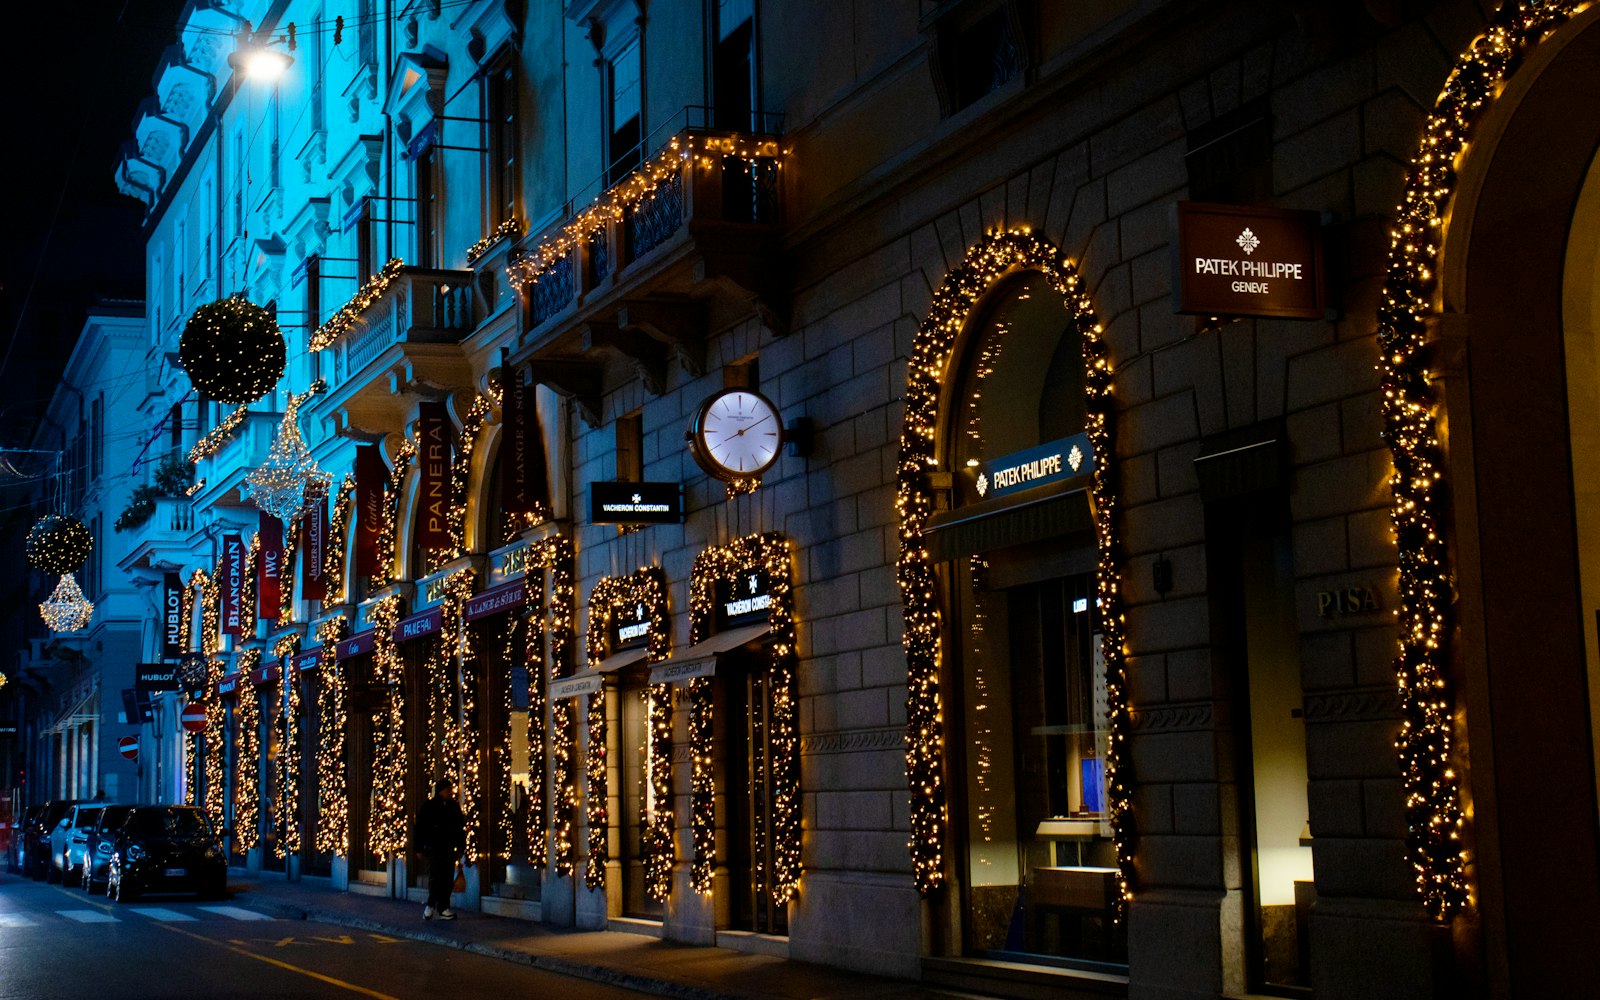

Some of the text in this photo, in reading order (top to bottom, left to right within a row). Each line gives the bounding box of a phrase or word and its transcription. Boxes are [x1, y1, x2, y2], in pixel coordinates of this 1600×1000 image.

[1195, 257, 1302, 280] PATEK PHILIPPE
[1231, 280, 1269, 294] GENEVE
[515, 414, 525, 426] &
[515, 429, 525, 484] LANGE
[428, 417, 443, 533] PANERAI
[993, 453, 1062, 490] PATEK PHILIPPE
[364, 489, 377, 532] Cartier
[602, 504, 670, 512] VACHERON CONSTANTIN
[264, 550, 277, 578] IWC
[228, 541, 241, 627] BLANCPAIN
[167, 588, 181, 645] HUBLOT
[1317, 588, 1380, 617] PISA
[141, 673, 174, 681] HUBLOT
